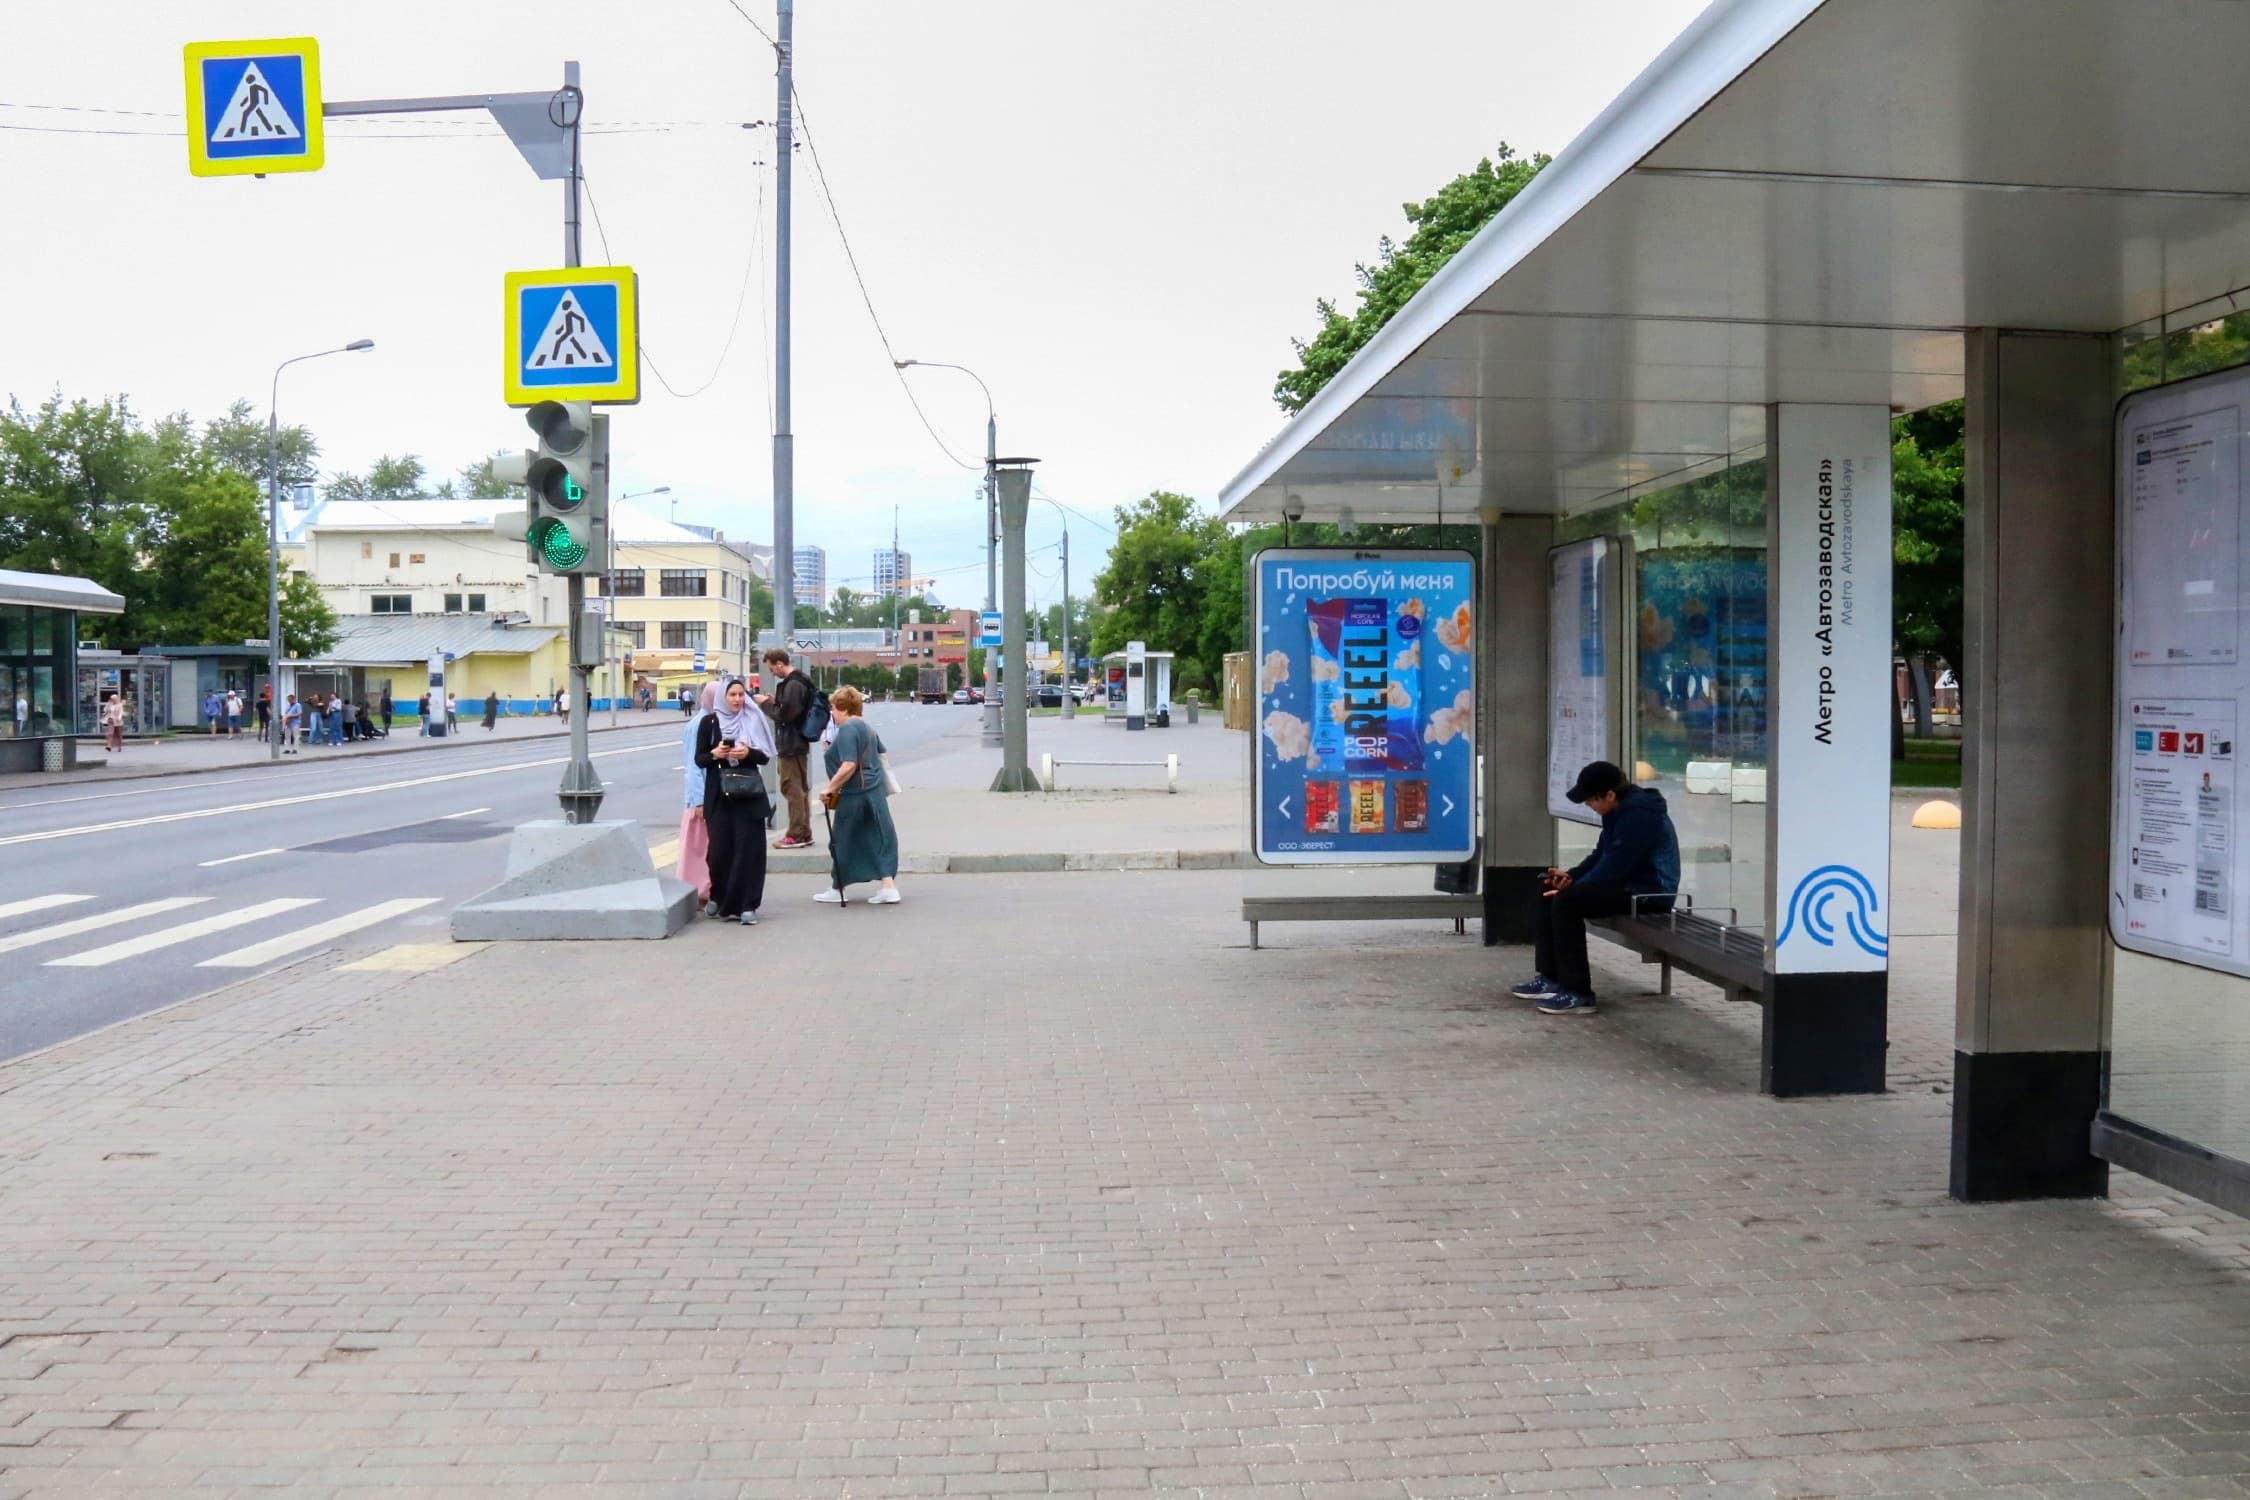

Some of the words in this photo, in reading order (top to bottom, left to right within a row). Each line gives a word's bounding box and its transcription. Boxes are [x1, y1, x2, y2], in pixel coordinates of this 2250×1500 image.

[1840, 458, 1853, 574] Avtozavodskaya
[1814, 458, 1836, 657] «Автозаводская»
[1277, 568, 1395, 595] Попробуй
[1401, 575, 1454, 590] меня
[1841, 580, 1853, 626] Metro
[1344, 628, 1388, 735] REEEL
[1814, 665, 1836, 745] Метро
[1344, 736, 1388, 747] POP
[1344, 748, 1388, 758] CORN
[1278, 842, 1297, 850] ООО
